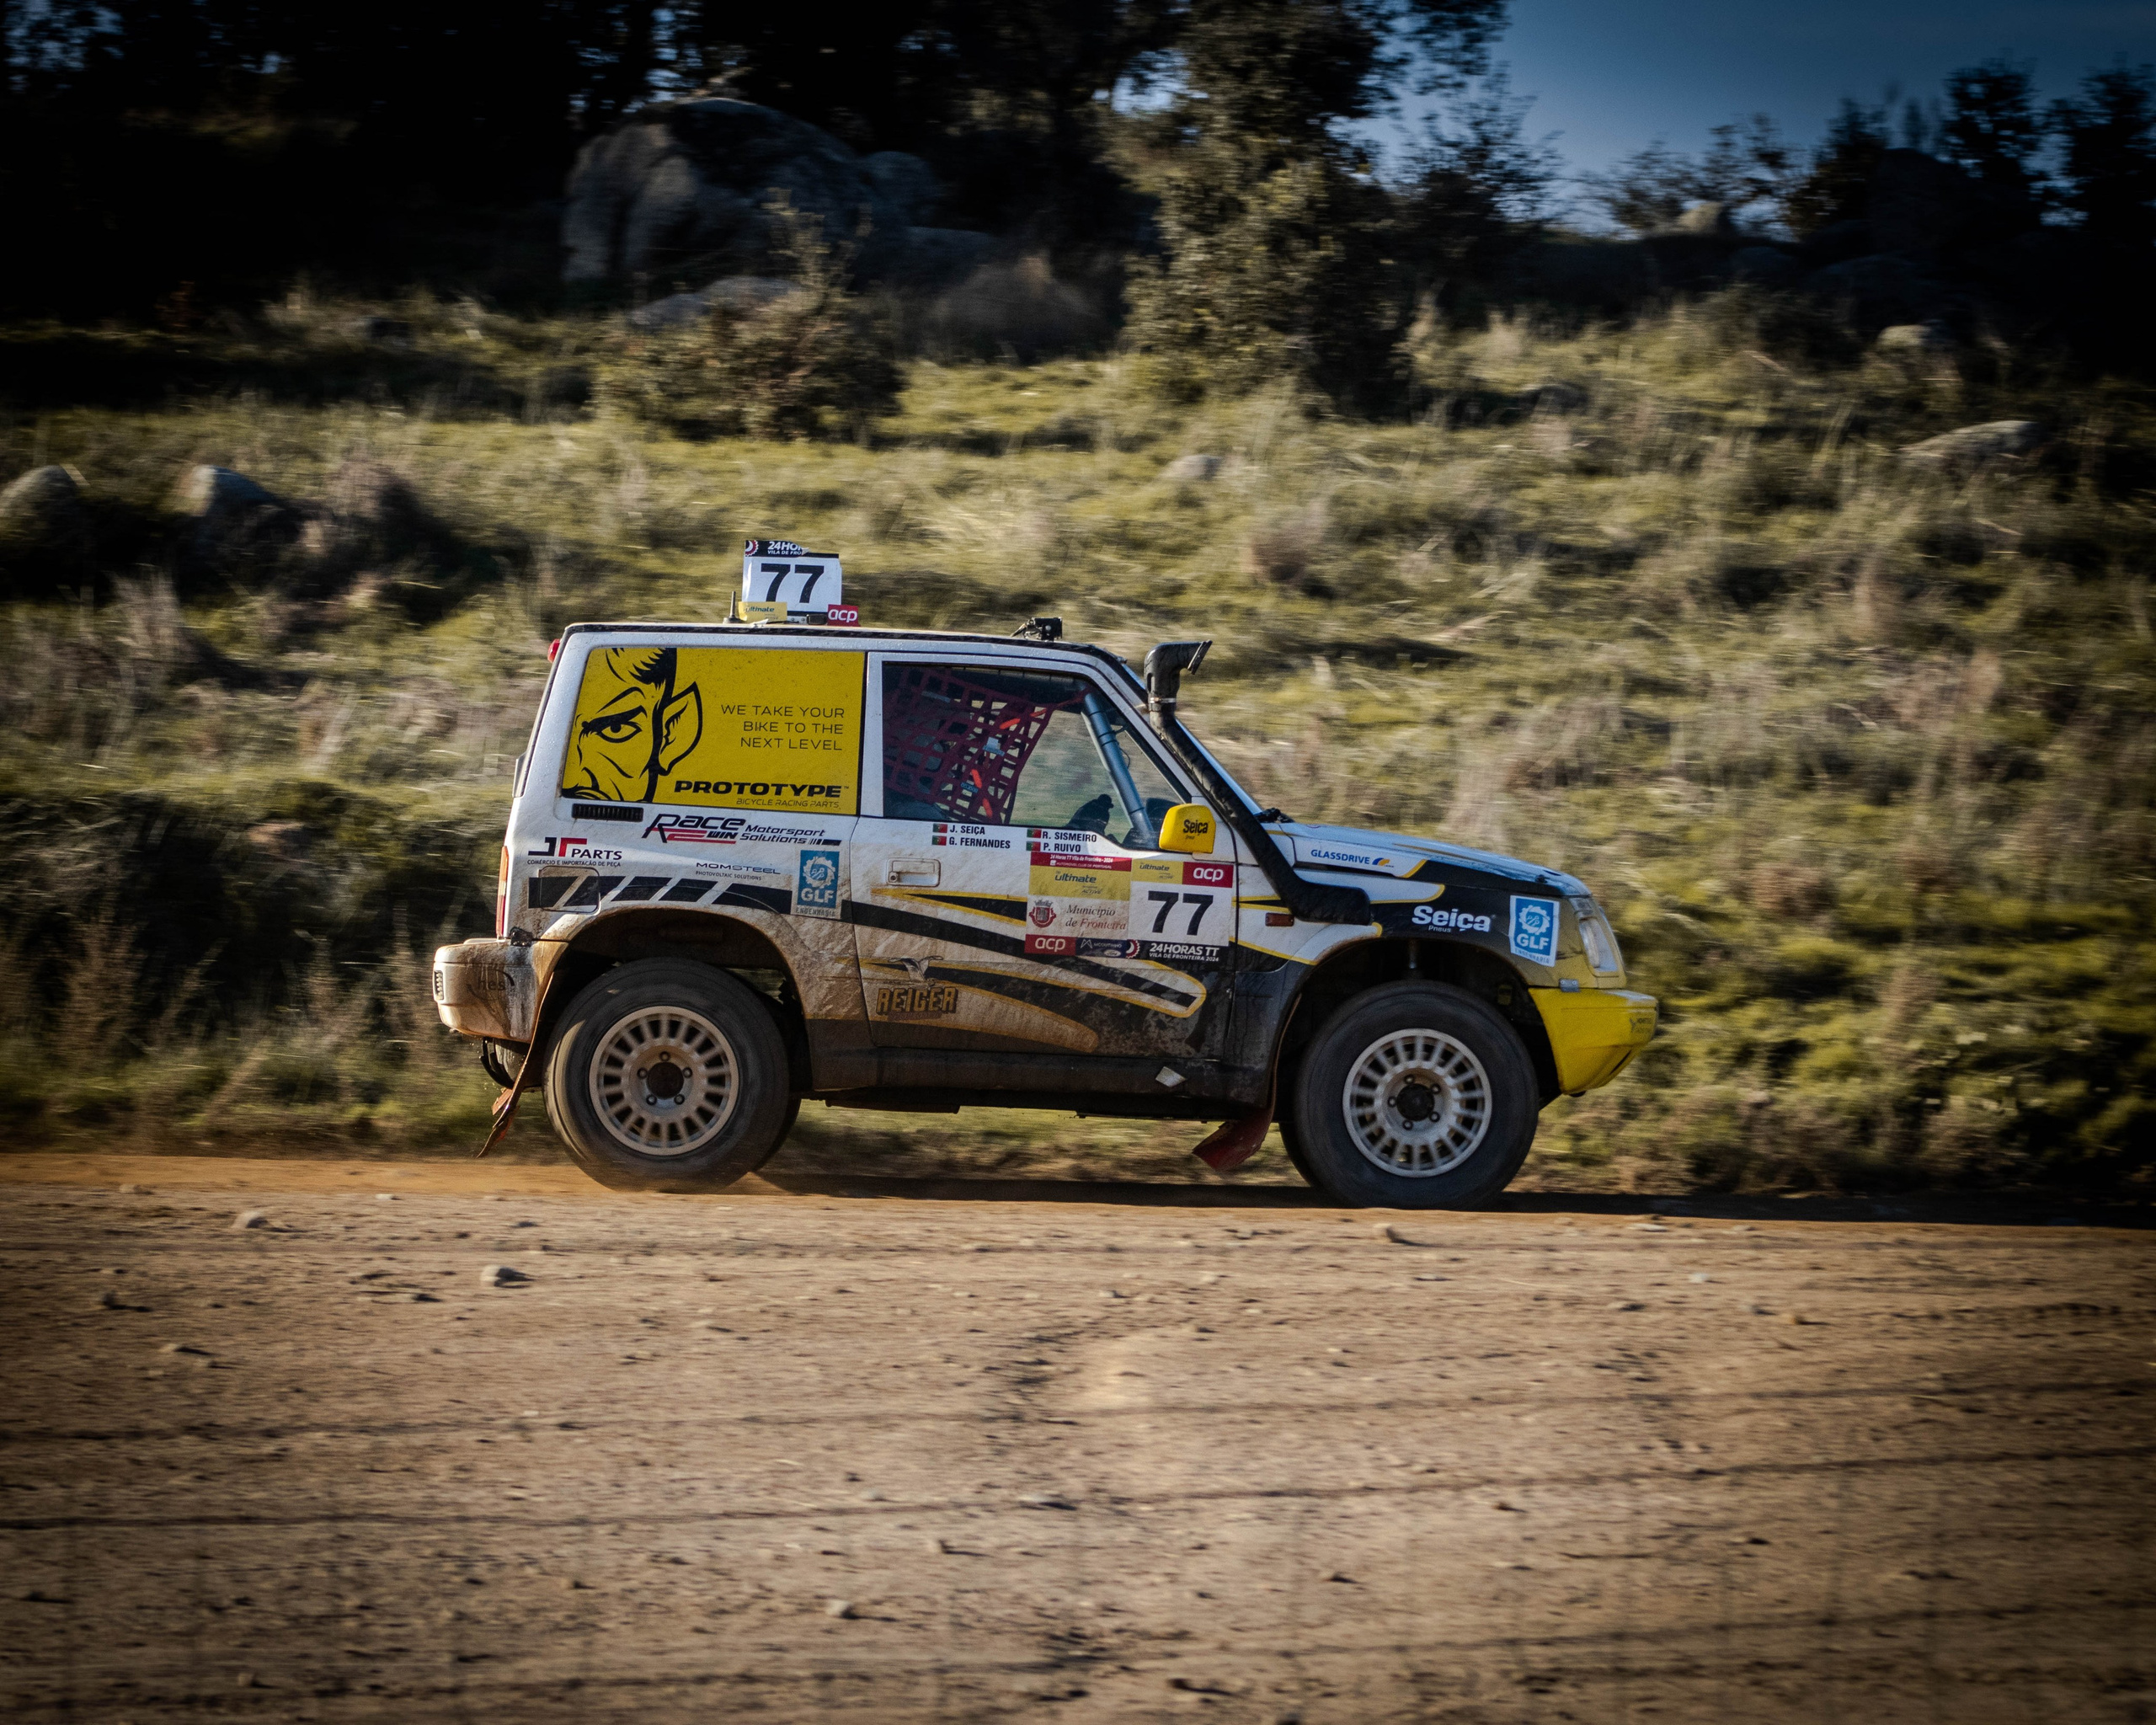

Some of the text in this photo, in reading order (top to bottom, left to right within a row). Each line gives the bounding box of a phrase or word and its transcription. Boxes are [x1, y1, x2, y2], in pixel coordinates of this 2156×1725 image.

[760, 563, 825, 604] 77
[828, 608, 857, 622] acp
[721, 704, 844, 718] WE TAKE YOUR
[744, 721, 843, 734] BIKE TO THE
[740, 737, 842, 750] NEXT LEVEL
[674, 781, 842, 798] PROTOTYPE
[810, 800, 839, 809] PARTS
[745, 825, 825, 836] Motorsport
[960, 825, 985, 836] SEIÇA
[1182, 819, 1209, 836] Seiça
[707, 830, 737, 839] WIN
[739, 833, 807, 844] Solutions
[1054, 832, 1097, 842] SISMEIRO
[948, 837, 1011, 849] G. FERNANDES
[1043, 842, 1081, 852] P. RUIVO
[571, 848, 622, 860] PARTS
[1310, 849, 1370, 865] GLASSDRIVE
[1054, 873, 1097, 883] ultimate
[1193, 868, 1224, 883] acp
[801, 888, 835, 903] GLF
[1148, 890, 1214, 936] 77
[1412, 905, 1492, 932] Seiça
[1065, 917, 1126, 930] de Fronteira
[1035, 937, 1065, 953] acp
[1516, 933, 1550, 950] GLF
[1205, 947, 1219, 957] TT
[876, 986, 958, 1014] REIGER
